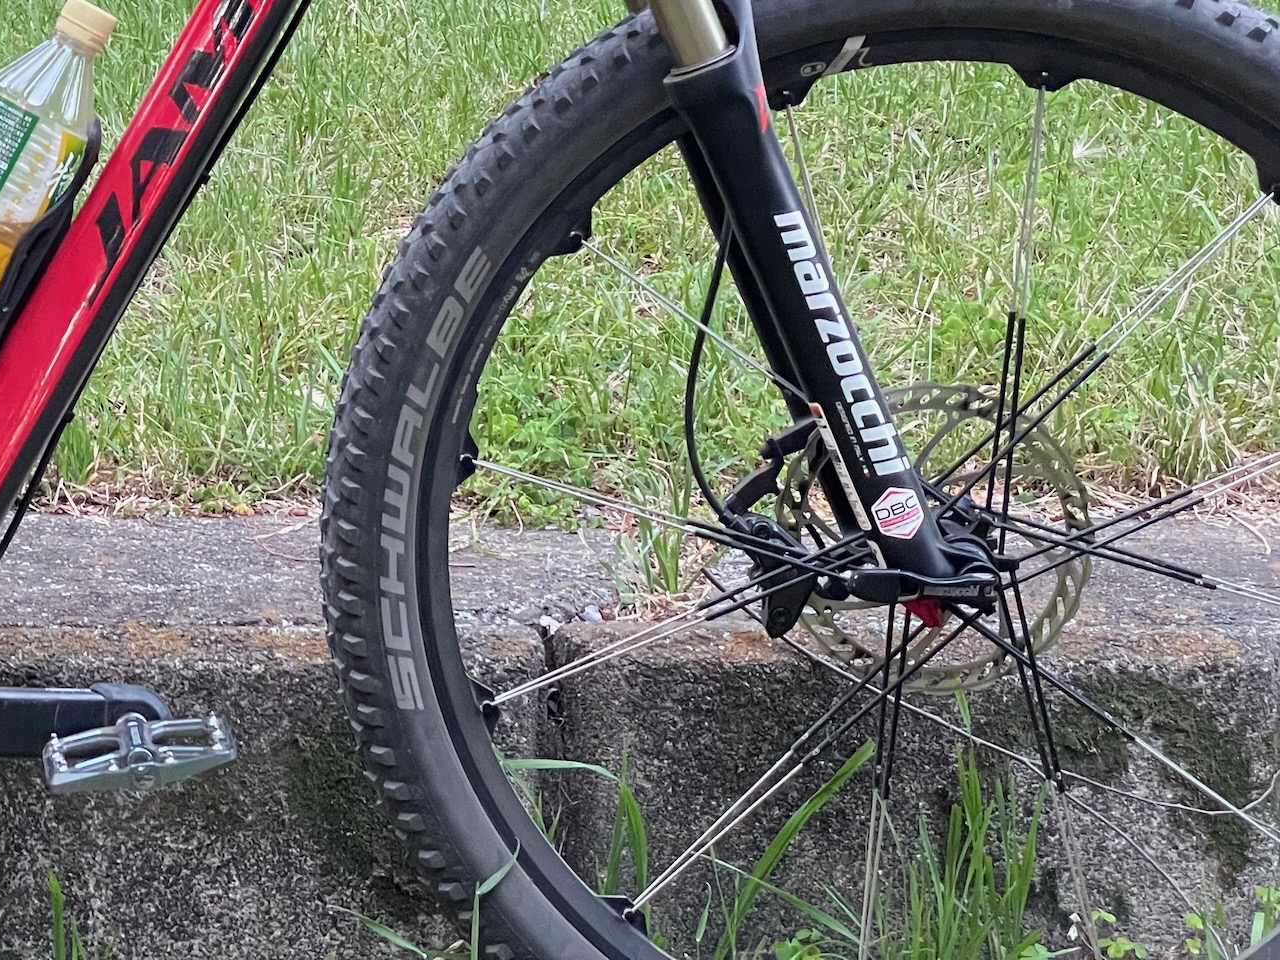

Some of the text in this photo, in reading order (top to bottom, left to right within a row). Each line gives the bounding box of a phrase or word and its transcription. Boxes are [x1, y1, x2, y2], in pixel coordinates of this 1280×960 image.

[773, 210, 911, 477] marzocchi
[379, 246, 494, 710] SCHWALBE
[874, 494, 918, 521] DBC
